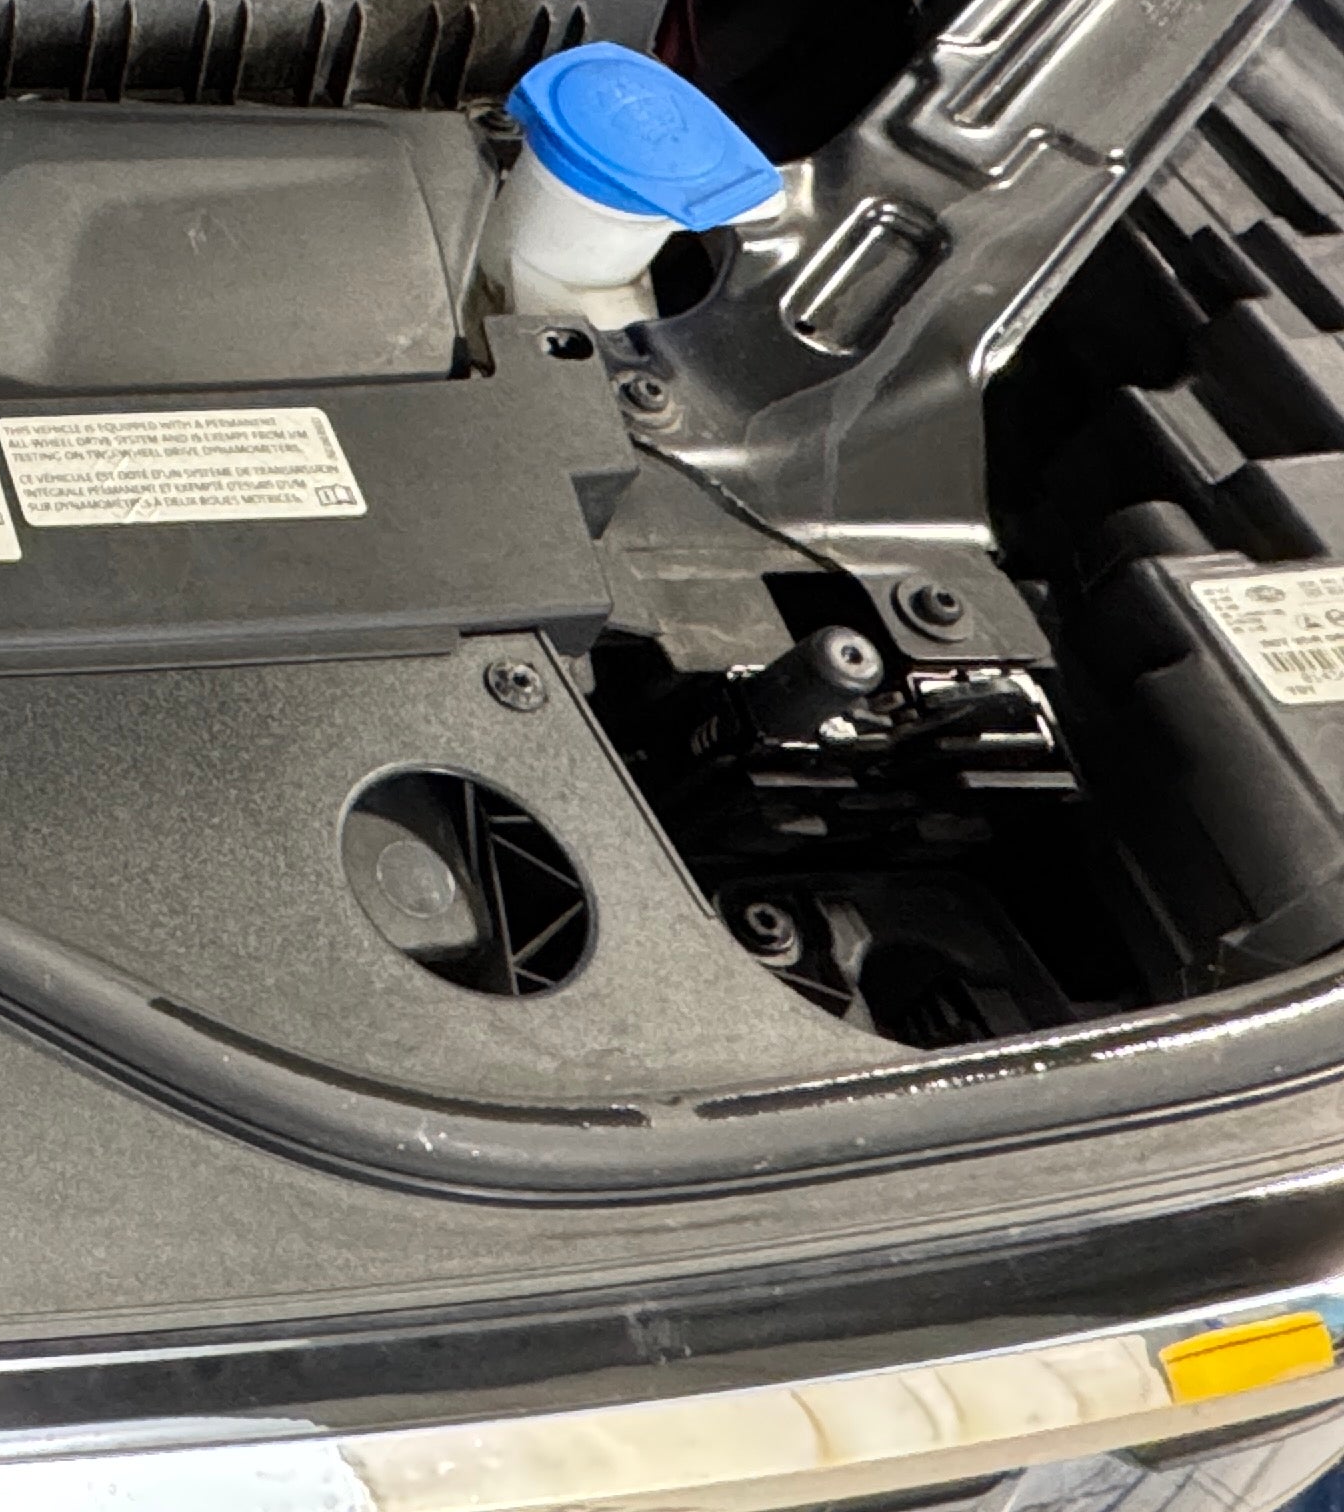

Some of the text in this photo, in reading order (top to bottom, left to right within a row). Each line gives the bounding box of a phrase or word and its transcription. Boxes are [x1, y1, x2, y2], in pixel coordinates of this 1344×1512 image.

[3, 425, 31, 436] THIS
[32, 423, 81, 434] VEHICLE
[98, 421, 157, 433] EQUIPPED
[159, 419, 192, 430] WITH
[194, 419, 204, 429] A
[114, 434, 158, 445] SYSTEM
[161, 433, 188, 444] AND
